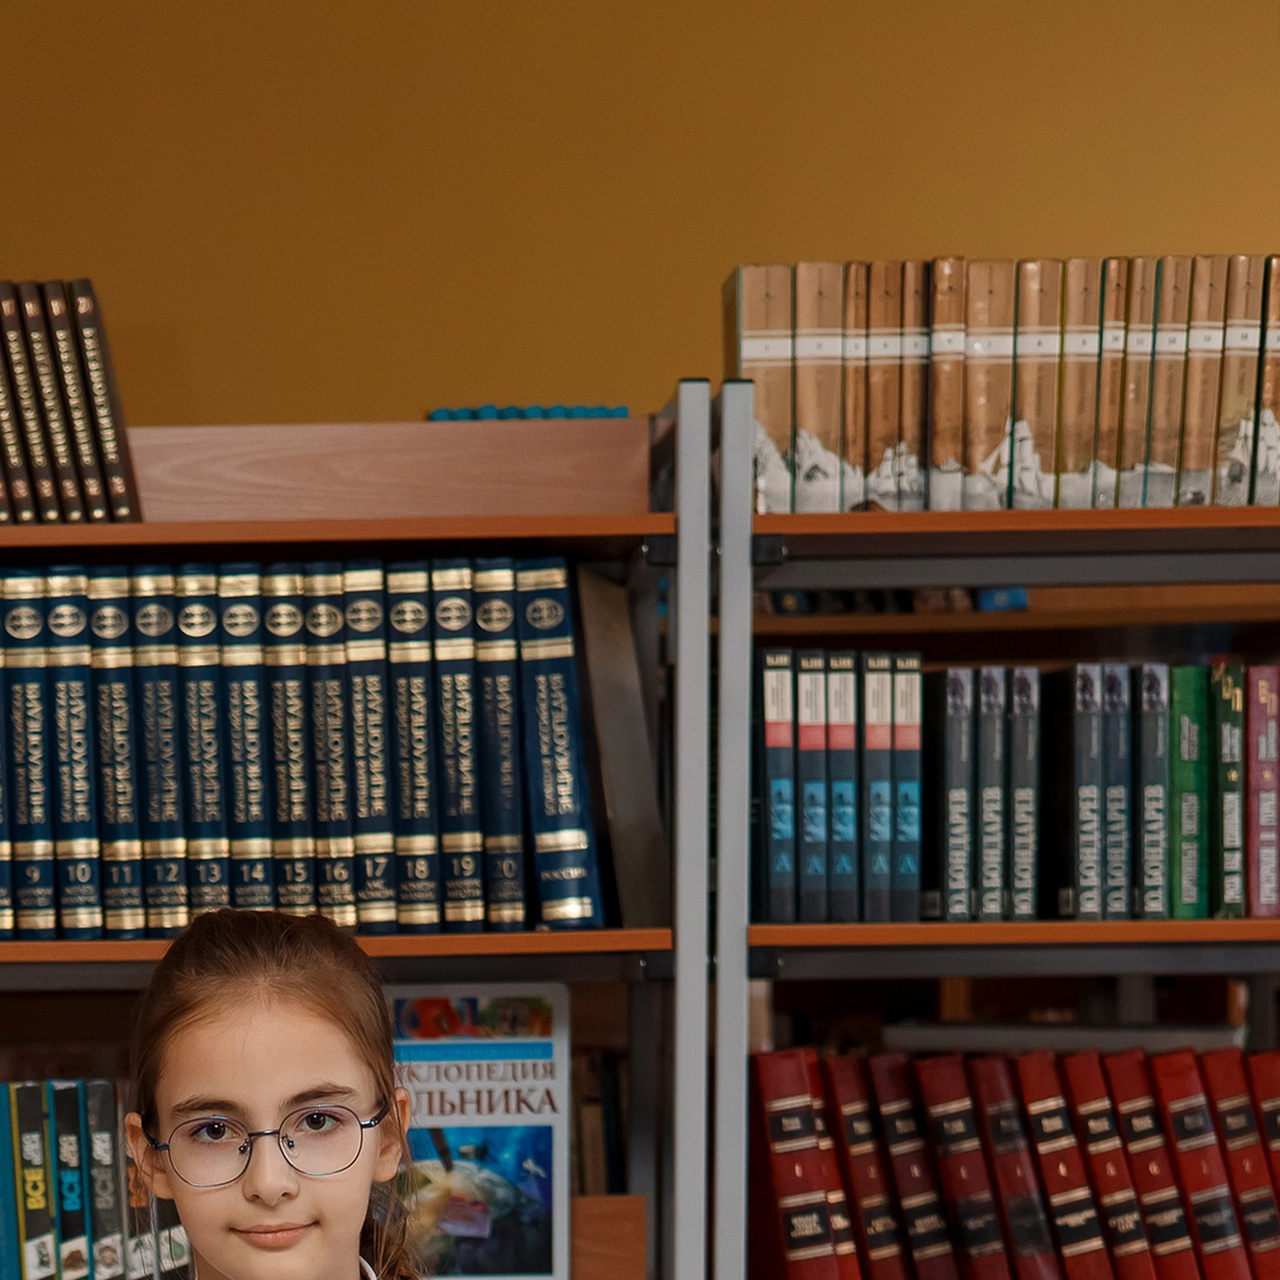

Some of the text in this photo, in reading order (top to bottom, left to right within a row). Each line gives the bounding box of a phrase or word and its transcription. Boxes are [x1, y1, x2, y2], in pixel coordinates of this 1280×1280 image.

[25, 683, 45, 824] ЭНЦИКЛОПЕДИЯ
[70, 681, 90, 822] ЭНЦИКЛОПЕДИЯ
[112, 682, 134, 823] ЭНЦИКЛОПЕДИЯ
[156, 680, 178, 821] ЭНЦИКЛОПЕДИЯ
[199, 680, 221, 821] ЭНЦИКЛОПЕДИЯ
[243, 680, 264, 821] ЭНЦИКЛОПЕДИЯ
[286, 680, 308, 820] ЭНЦИКЛОПЕДИЯ
[327, 679, 348, 820] ЭНЦИКЛОПЕДИЯ
[367, 675, 387, 816] ЭНЦИКЛОПЕДИЯ
[410, 677, 429, 818] ЭНЦИКЛОПЕДИЯ
[550, 672, 574, 814] ЭНЦИКЛОПЕДИЯ
[26, 865, 40, 884] 9
[68, 863, 91, 883] 10
[111, 866, 132, 883] 11
[155, 863, 179, 882] 12
[196, 862, 222, 883] 13
[240, 863, 265, 882] 14
[284, 862, 308, 882] 15
[325, 862, 349, 882] 16
[365, 857, 390, 877] 17
[406, 858, 429, 879] 18
[453, 855, 476, 877] 19
[948, 788, 969, 889] БОНДАРЕВ
[981, 786, 1003, 887] БОНДАРЕВ
[1014, 786, 1034, 888] БОНДАРЕВ
[1077, 784, 1100, 885] БОНДАРЕВ
[1106, 784, 1128, 885] БОНДАРЕВ
[1143, 784, 1165, 885] БОНДАРЕВ
